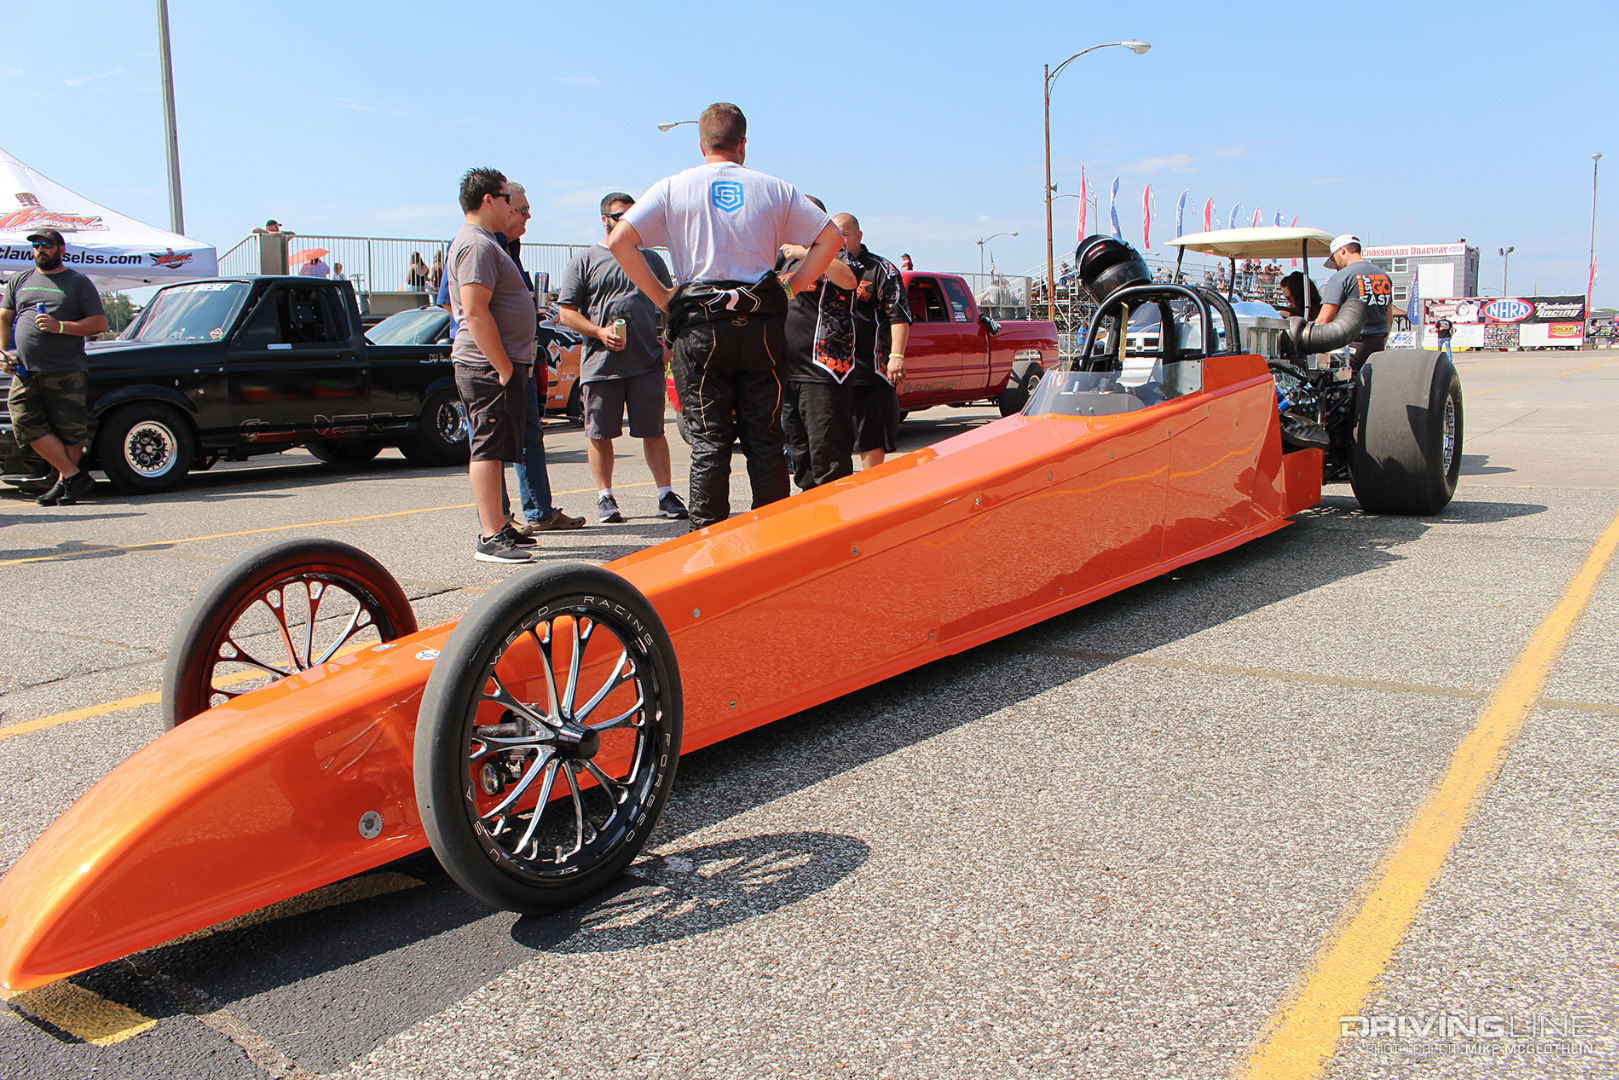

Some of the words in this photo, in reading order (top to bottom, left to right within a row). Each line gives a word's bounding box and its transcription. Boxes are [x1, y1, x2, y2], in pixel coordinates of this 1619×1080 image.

[1361, 247, 1409, 257] CROSSROADS
[1410, 246, 1448, 256] DRAGWAY
[1371, 280, 1391, 295] GO
[1359, 294, 1391, 306] FAST
[1490, 302, 1526, 318] NHRA
[914, 379, 960, 393] SUNCOAST
[490, 606, 549, 665] WELD
[583, 595, 654, 647] RACING
[625, 733, 671, 842] FORGED
